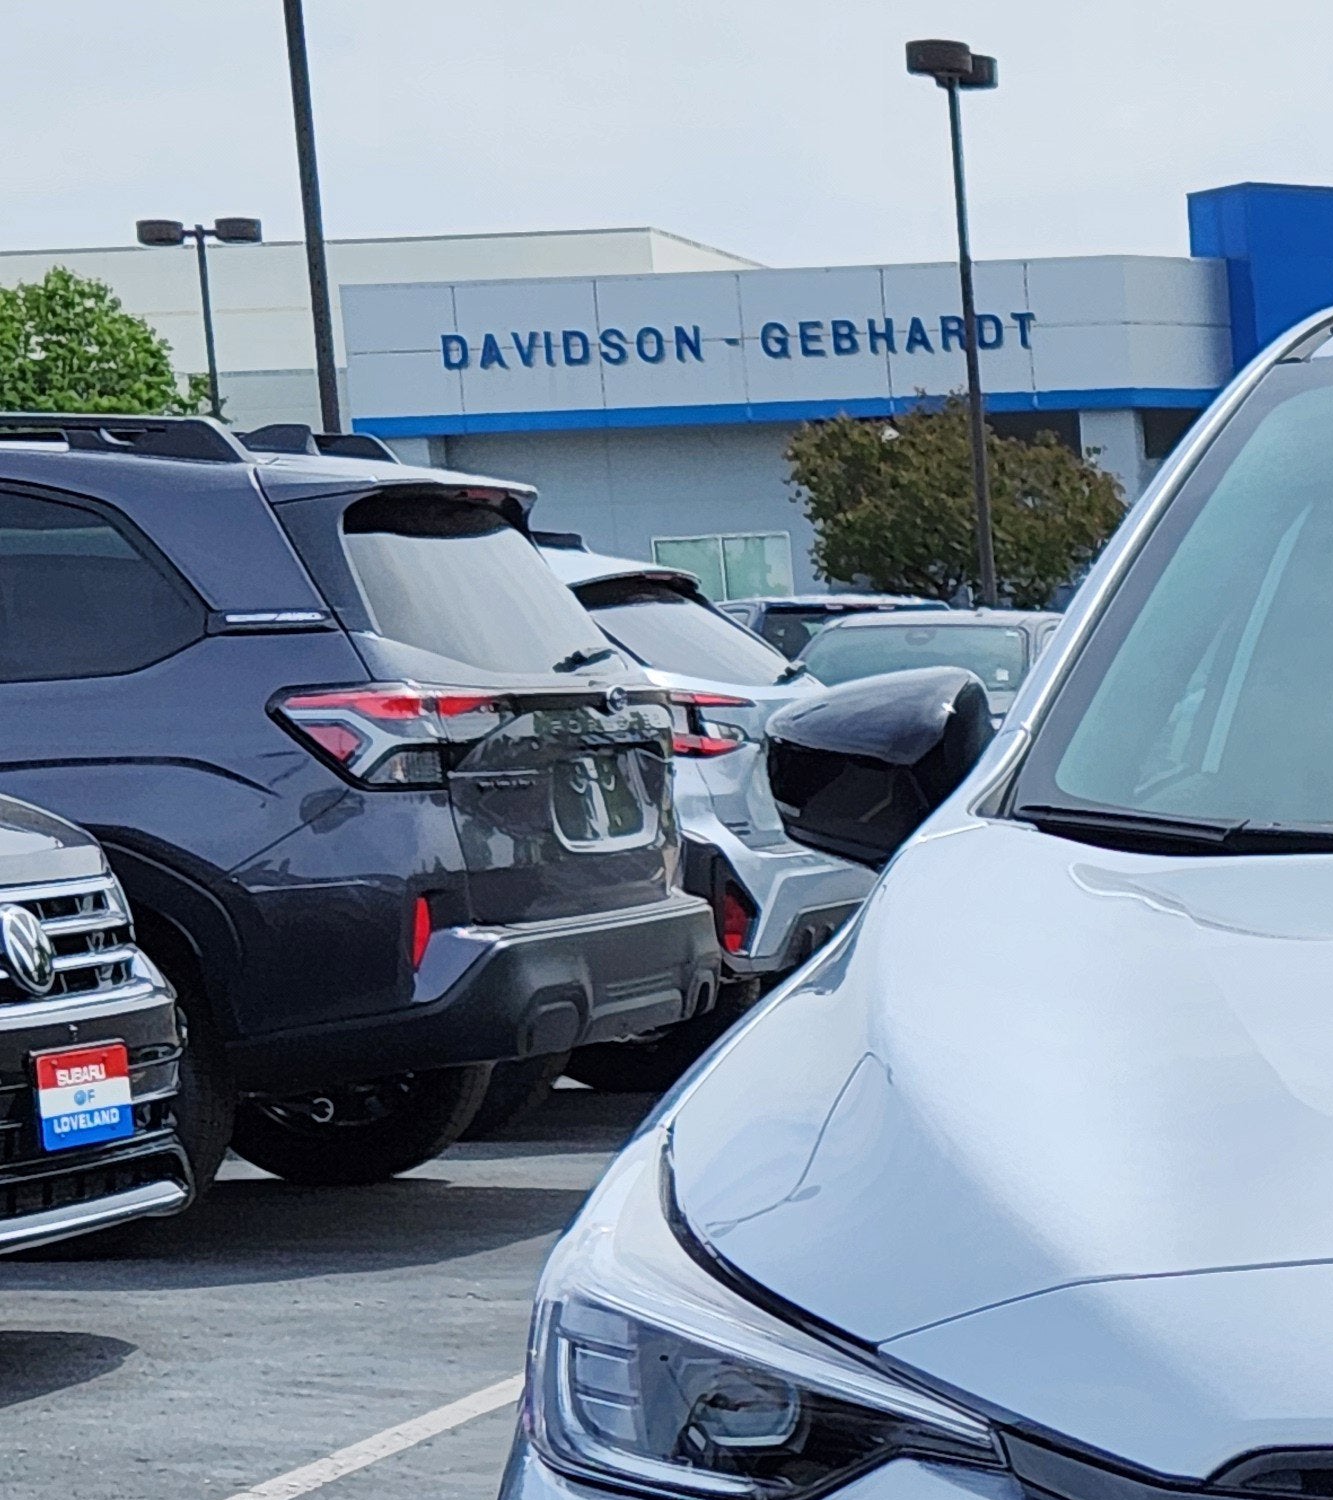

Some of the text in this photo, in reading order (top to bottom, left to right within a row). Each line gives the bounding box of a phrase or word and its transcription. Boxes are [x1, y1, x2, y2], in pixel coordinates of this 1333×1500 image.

[440, 325, 705, 370] DAVIDSON
[760, 311, 1036, 359] GEBHARDT
[56, 1063, 106, 1086] SUBARU
[53, 1108, 120, 1134] LOVELAND
